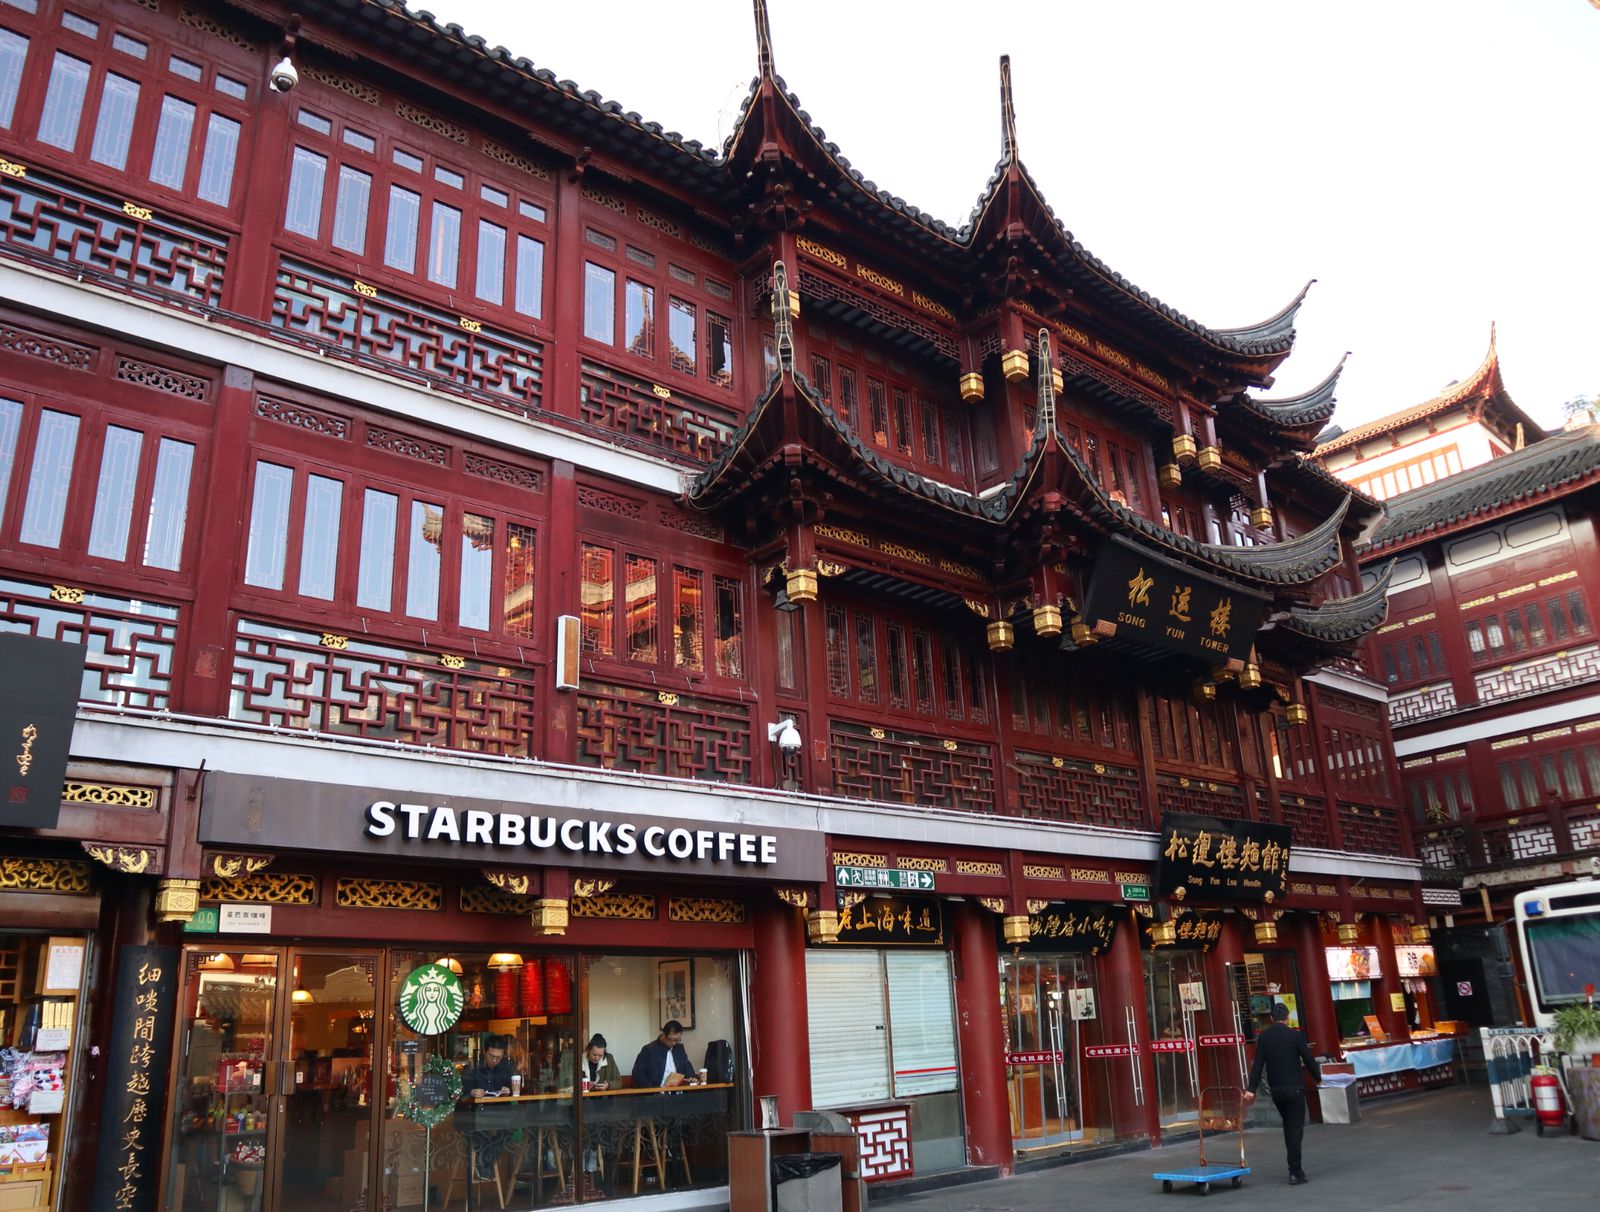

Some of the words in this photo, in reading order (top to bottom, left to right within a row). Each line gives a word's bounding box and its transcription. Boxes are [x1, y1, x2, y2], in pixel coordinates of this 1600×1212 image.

[1117, 611, 1146, 629] SONG
[1165, 626, 1185, 640] YUN
[1200, 637, 1230, 654] TOWER
[367, 800, 637, 854] STARBUCKS
[643, 826, 777, 864] COFFEE
[226, 911, 266, 919] 星巴克咖啡
